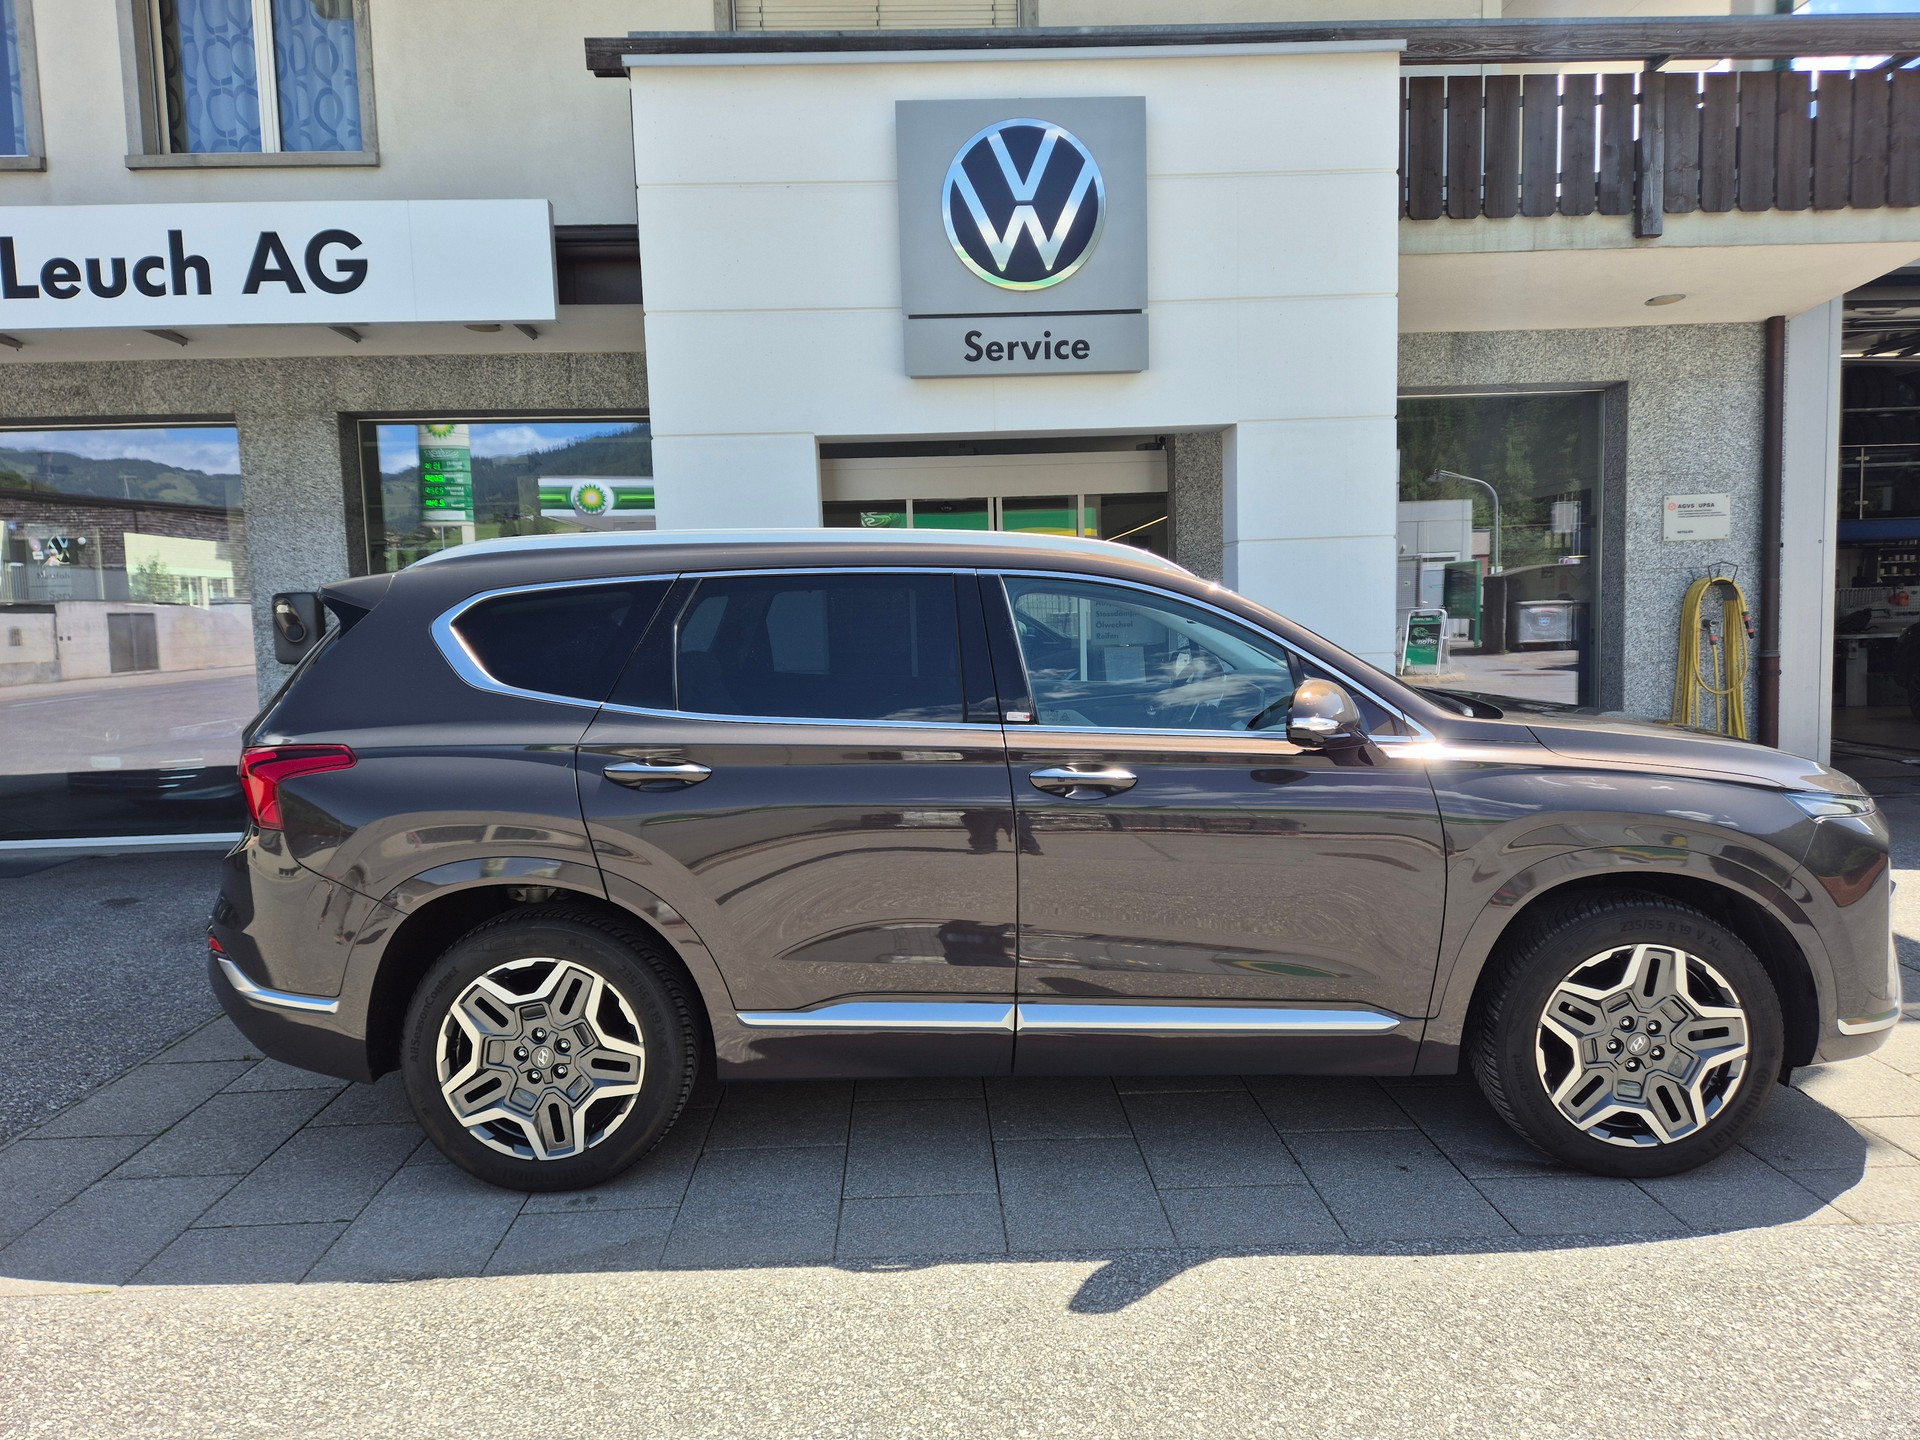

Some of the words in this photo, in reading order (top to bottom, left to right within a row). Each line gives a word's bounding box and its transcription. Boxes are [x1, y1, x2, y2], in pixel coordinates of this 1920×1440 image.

[0, 229, 212, 299] Leuch
[242, 229, 369, 295] AG
[963, 329, 1091, 363] Service
[1619, 919, 1664, 933] 235/55
[1666, 921, 1677, 933] R
[409, 965, 460, 1063] AllSeasonContact
